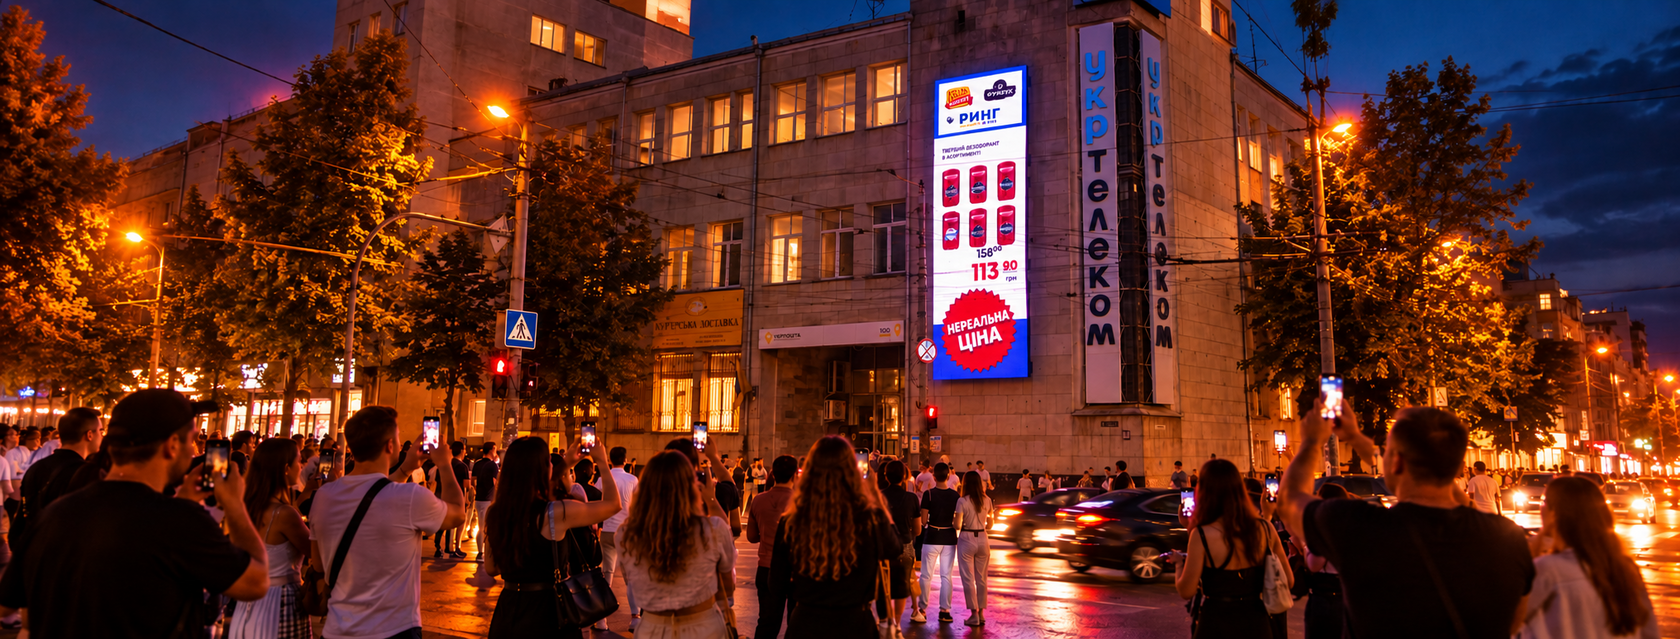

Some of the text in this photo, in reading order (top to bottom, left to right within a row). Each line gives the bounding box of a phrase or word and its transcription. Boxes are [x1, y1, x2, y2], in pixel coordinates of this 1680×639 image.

[959, 108, 1001, 124] РИНГ
[971, 261, 999, 281] 113
[947, 309, 1010, 336] НЕРЕАЛЬНА
[957, 326, 1003, 352] ЦІНА
